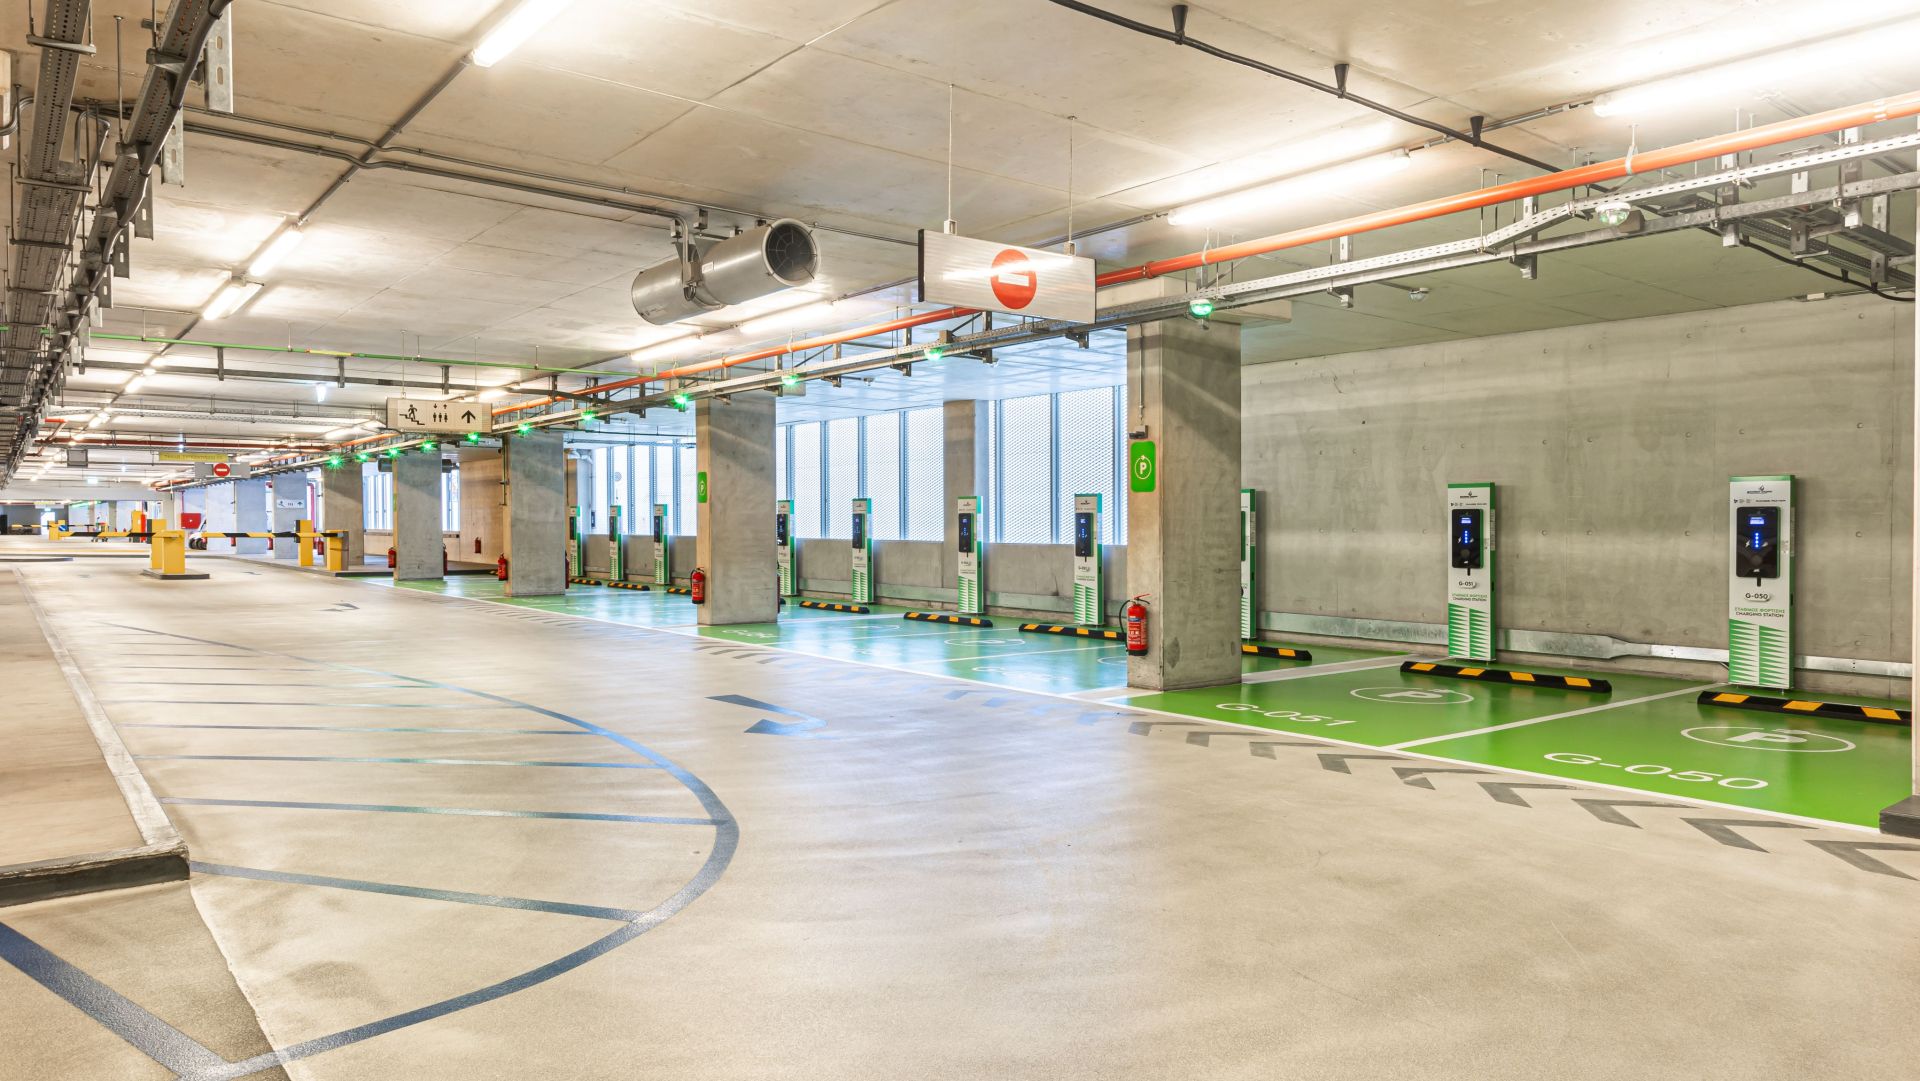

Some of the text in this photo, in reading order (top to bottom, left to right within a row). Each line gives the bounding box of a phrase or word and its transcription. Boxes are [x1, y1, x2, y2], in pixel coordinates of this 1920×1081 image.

[1140, 462, 1147, 474] P
[1216, 703, 1357, 726] G-051
[1725, 731, 1808, 743] P
[1543, 752, 1769, 790] G-050
